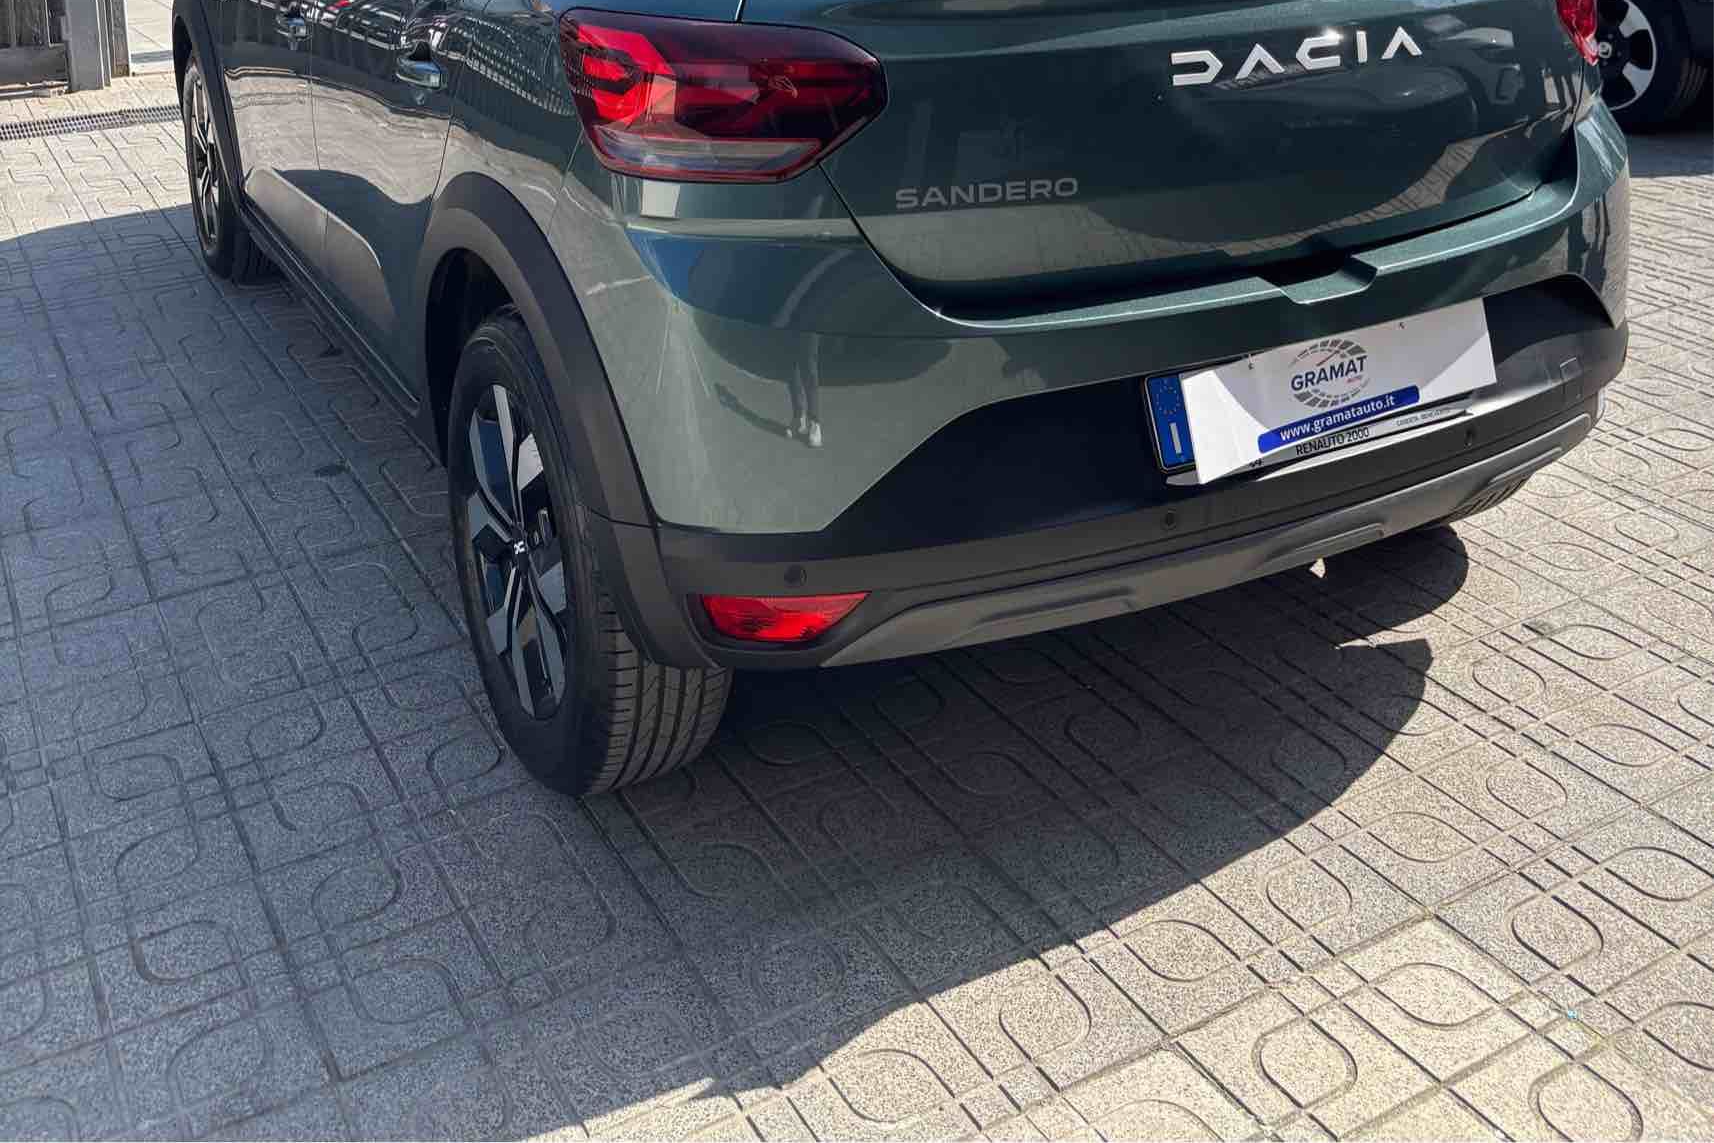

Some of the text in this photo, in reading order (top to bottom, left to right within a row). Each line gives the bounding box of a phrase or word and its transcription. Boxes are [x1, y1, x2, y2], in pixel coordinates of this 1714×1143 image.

[1170, 25, 1423, 86] DACIA
[895, 177, 1079, 210] SANDERO
[1291, 355, 1367, 391] GRAMAT
[1279, 394, 1395, 442] www.gramatauto.it
[1295, 426, 1370, 456] RENAUTO 2000
